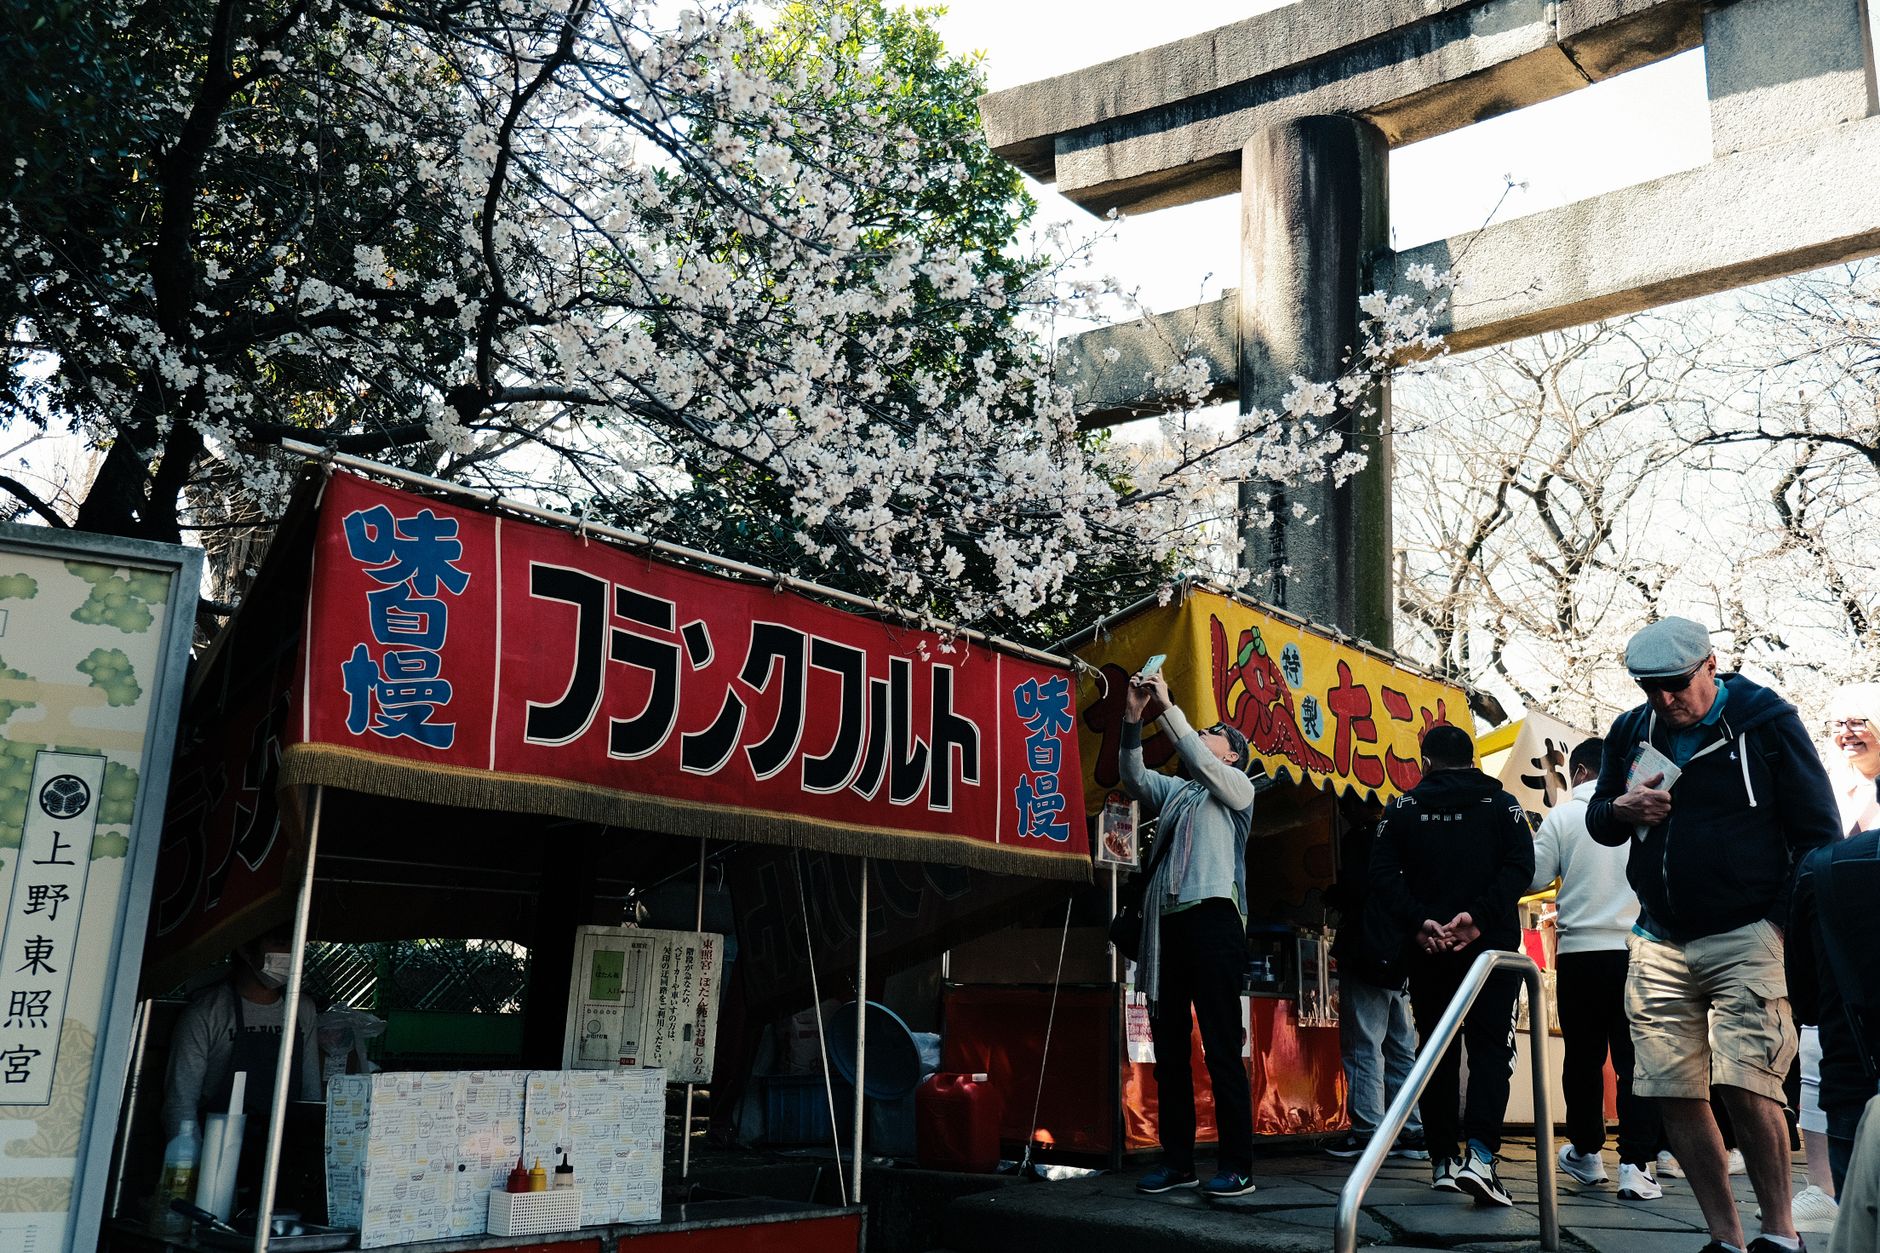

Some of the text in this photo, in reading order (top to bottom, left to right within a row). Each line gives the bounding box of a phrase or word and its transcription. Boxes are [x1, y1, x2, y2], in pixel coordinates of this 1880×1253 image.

[342, 504, 471, 750] 味自慢
[524, 559, 981, 813] フランクフルト
[1281, 646, 1321, 739] 特製
[1013, 675, 1075, 842] 味自慢
[0, 829, 76, 1086] 上野東照宮
